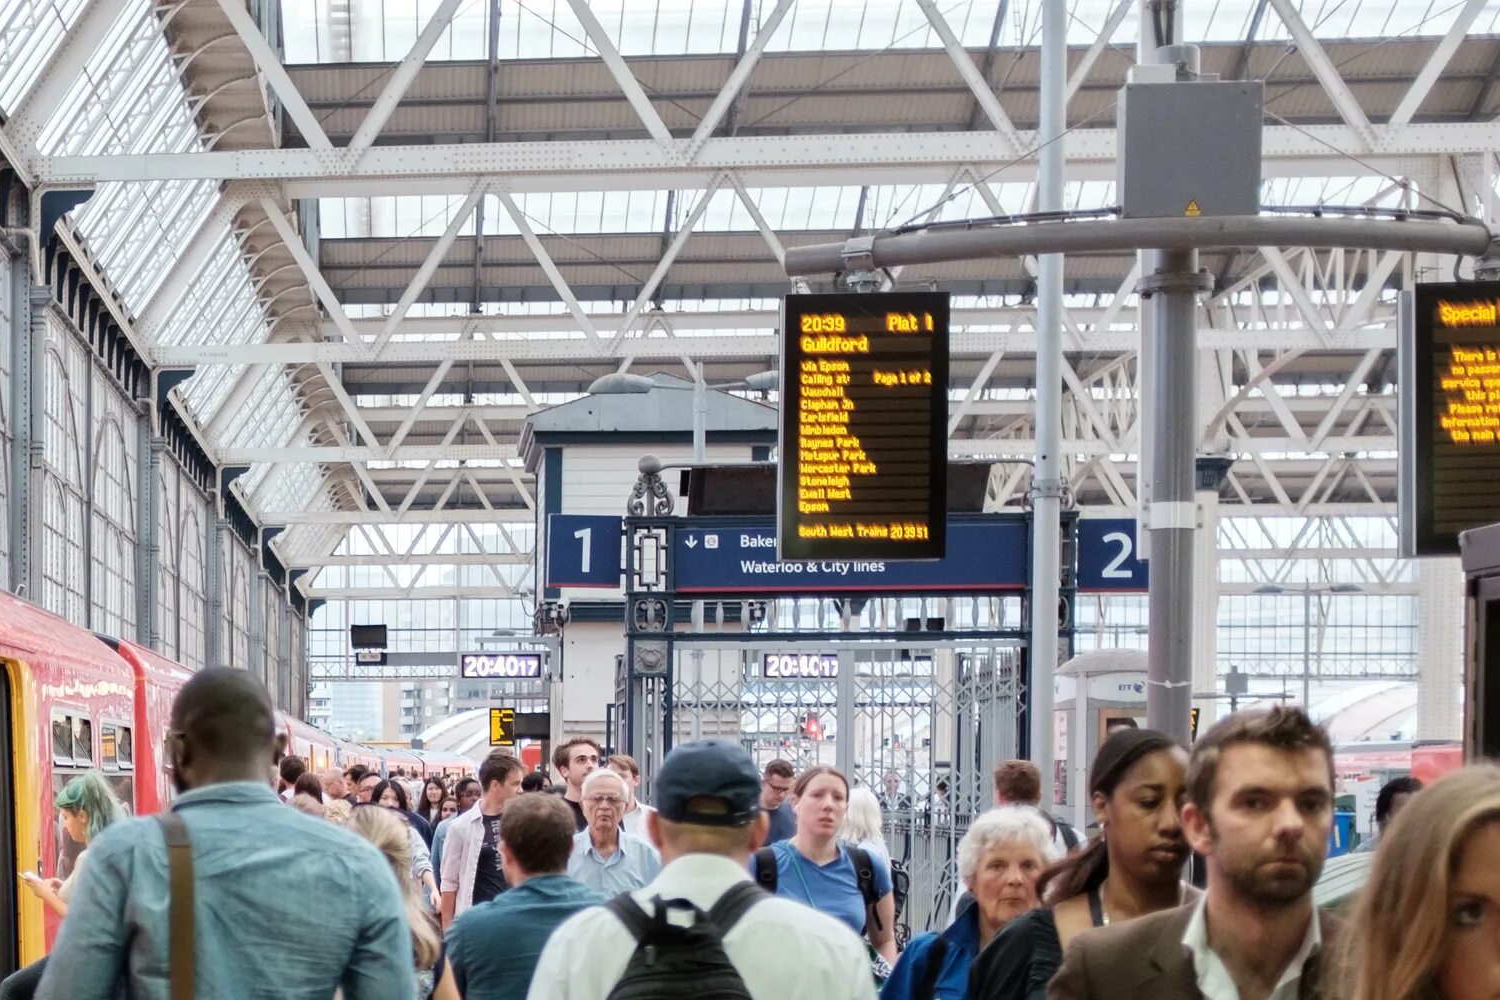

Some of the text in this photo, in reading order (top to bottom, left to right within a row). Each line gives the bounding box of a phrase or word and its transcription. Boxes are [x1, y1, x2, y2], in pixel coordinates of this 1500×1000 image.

[1442, 304, 1495, 323] Special
[801, 313, 932, 332] 20:39 Plat 1
[801, 336, 868, 352] Guildford
[1453, 351, 1496, 361] There is
[801, 361, 849, 373] via Epsom
[1452, 366, 1464, 374] no
[801, 374, 833, 385] Calling
[836, 374, 850, 384] at:
[874, 372, 898, 385] Page
[909, 372, 921, 383] of
[924, 372, 931, 383] 2
[1442, 378, 1480, 388] service
[801, 386, 844, 397] Vauxhall
[1466, 390, 1485, 400] this
[801, 399, 854, 411] Clapham Jn
[1449, 404, 1482, 413] Please
[801, 412, 849, 423] Earlsfield
[800, 425, 847, 435] Wimbledon
[1452, 430, 1470, 440] the
[800, 437, 860, 450] Raynes Park
[800, 450, 866, 461] Motspur Park
[800, 463, 877, 473] Worcester Park
[800, 475, 849, 487] Stoneleigh
[800, 488, 851, 499] Ewell West
[800, 501, 829, 513] Epsom
[799, 526, 827, 538] South
[830, 526, 854, 538] West
[857, 526, 888, 538] Trains
[574, 528, 591, 573] 1
[1102, 532, 1133, 578] 2
[740, 560, 886, 576] Waterloo & City lines
